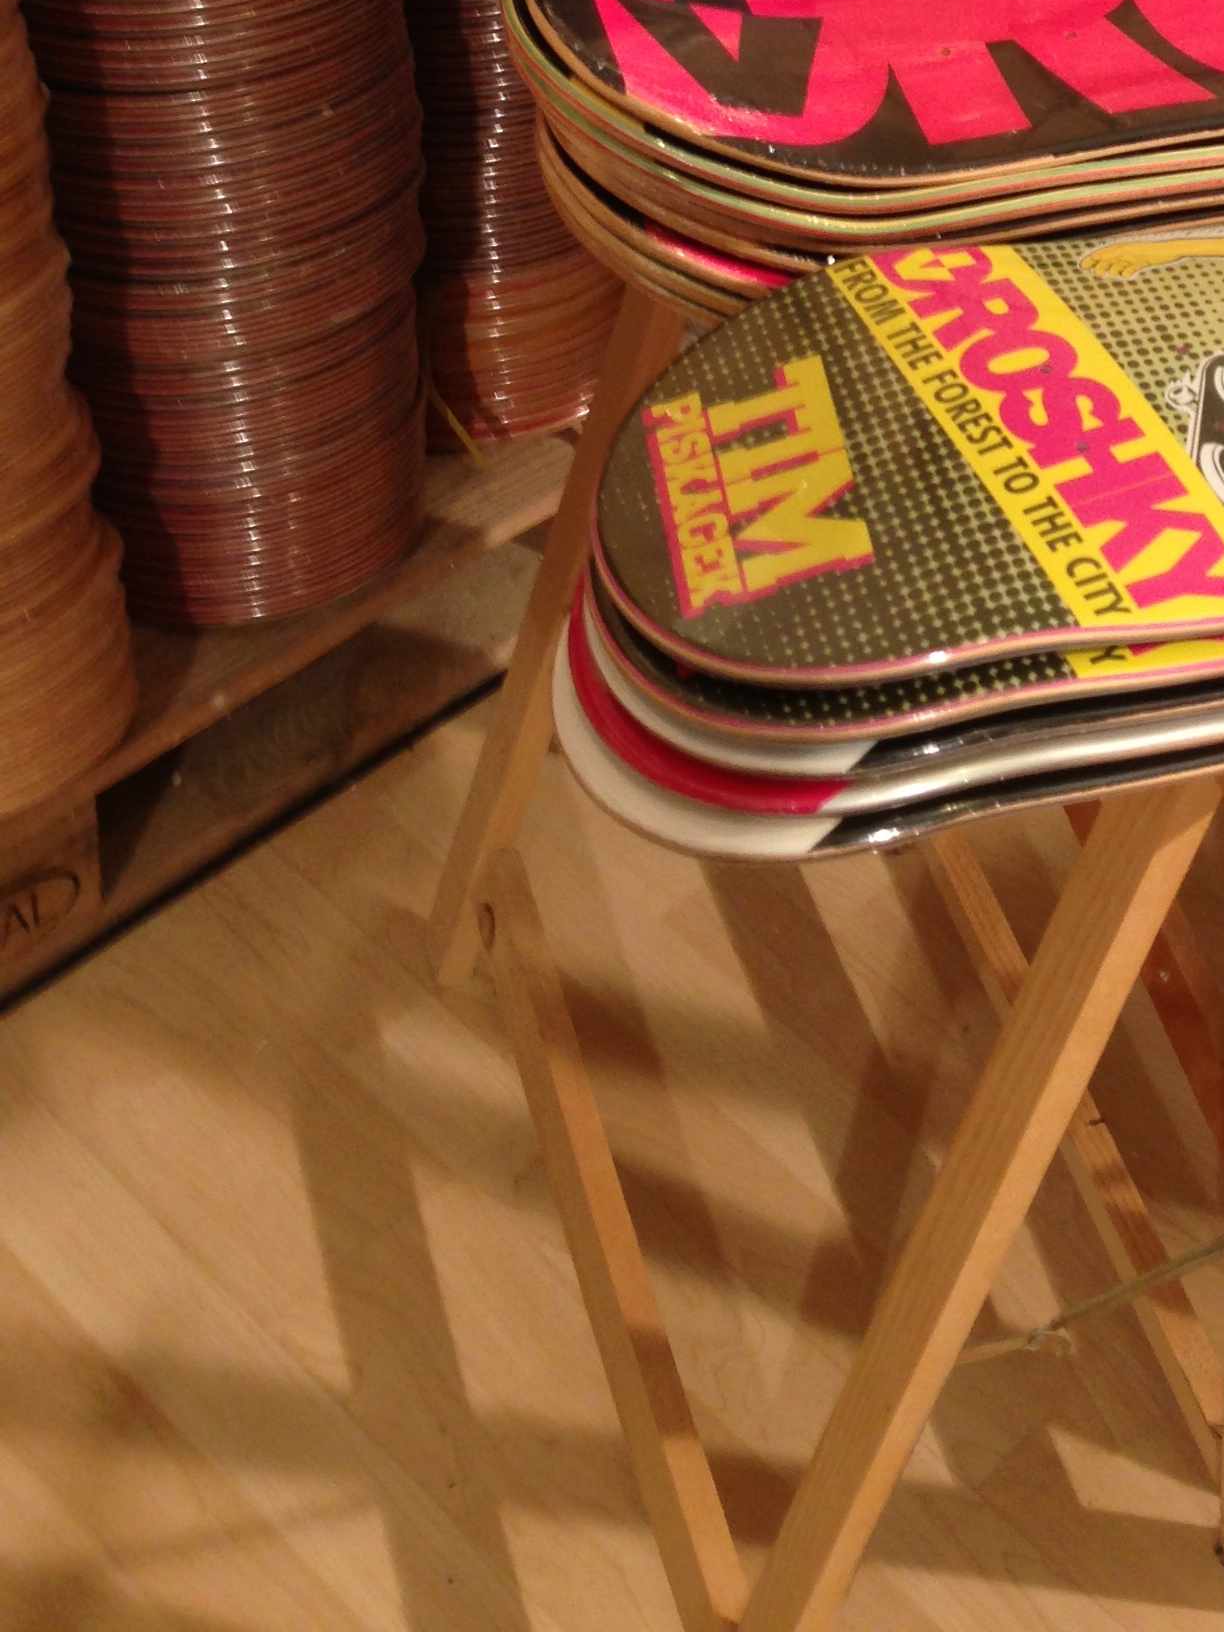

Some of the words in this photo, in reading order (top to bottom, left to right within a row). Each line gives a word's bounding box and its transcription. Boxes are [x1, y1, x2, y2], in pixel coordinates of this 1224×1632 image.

[704, 353, 875, 598] TIM
[844, 258, 905, 327] FROM
[887, 312, 943, 371] THE
[923, 365, 1014, 460] FOREST
[992, 447, 1040, 498] TO
[1023, 493, 1083, 554] THE
[1065, 551, 1134, 618] CITY
